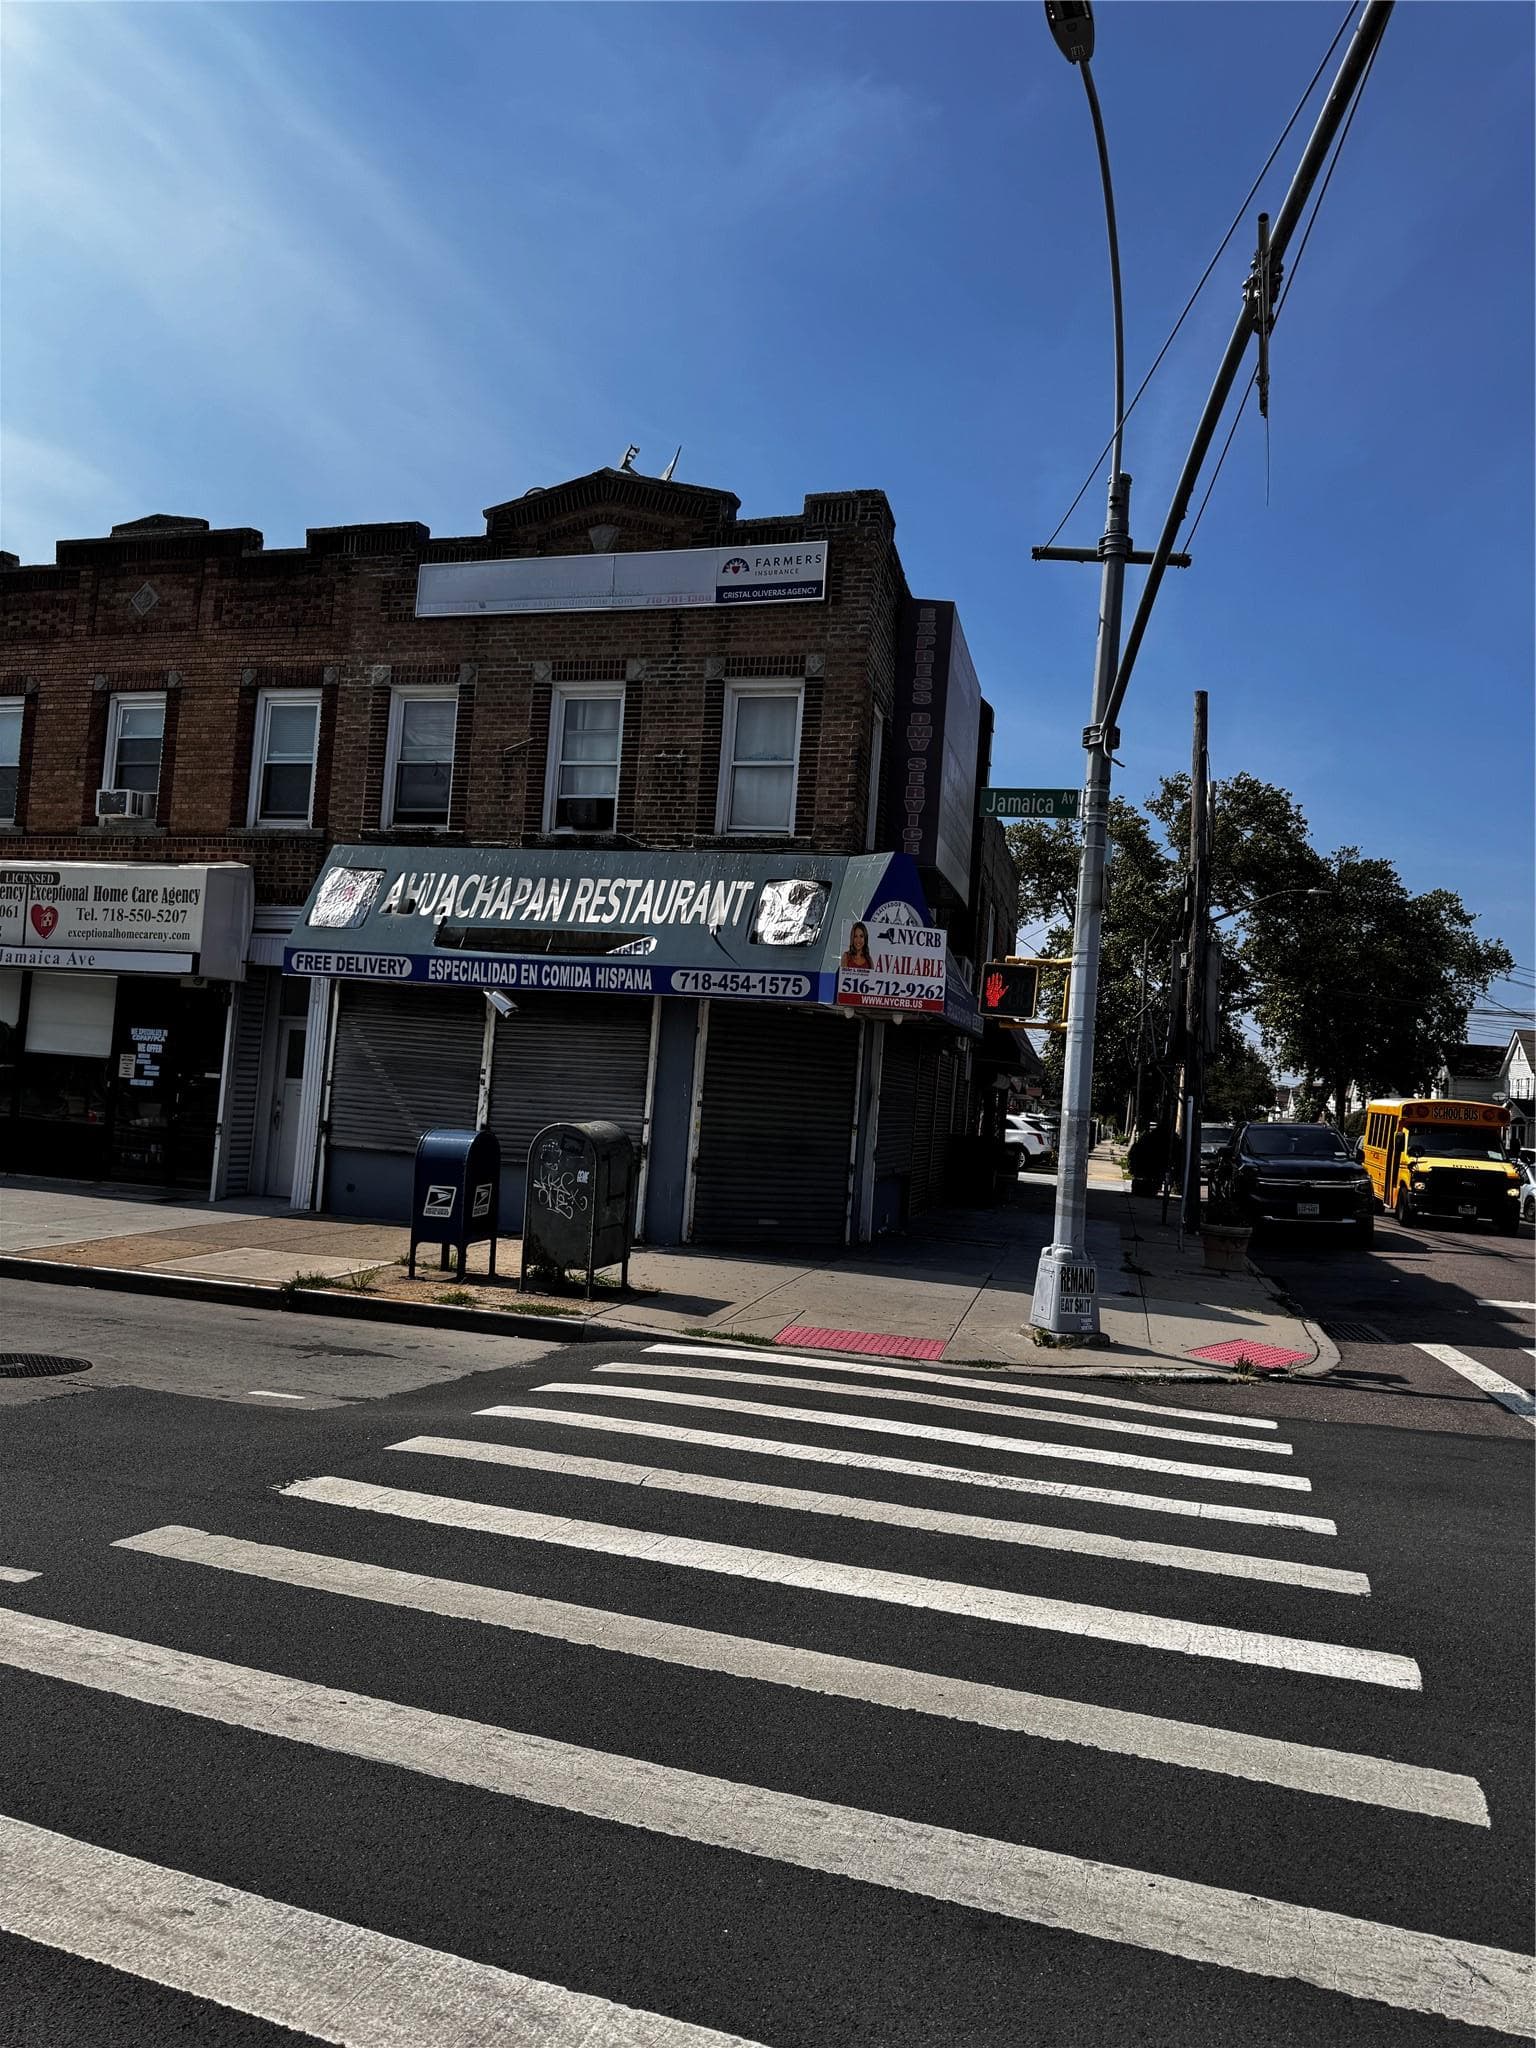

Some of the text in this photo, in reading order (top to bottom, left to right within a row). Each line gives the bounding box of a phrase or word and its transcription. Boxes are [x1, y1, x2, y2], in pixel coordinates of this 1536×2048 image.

[756, 554, 822, 568] FARMERS
[754, 568, 799, 577] INSURANCE
[722, 590, 751, 600] CRISTAL
[752, 588, 788, 598] OLIVERAS
[788, 586, 817, 596] AGENCY
[986, 792, 1075, 814] Jamaica Av
[6, 873, 54, 884] LICENSED
[30, 884, 200, 906] Exceptional Home Care Agency
[379, 872, 754, 926] AHUACHAPAN RESTAURANT
[76, 907, 188, 924] Tel. 718-550-5207
[68, 928, 190, 942] exceptionalhomecareny.com
[897, 928, 942, 948] NYCRB
[66, 951, 96, 967] Ave
[296, 954, 407, 976] FREE DELIVERY
[874, 954, 944, 978] AVAILABLE
[428, 959, 652, 991] ESPECIALIDAD EN COMIDA HISPANA
[680, 972, 803, 995] 718-454-1575
[842, 978, 944, 1000] 516-712-9262
[862, 996, 923, 1009] WWW.NYCRB.US
[1434, 1107, 1478, 1120] SCHOOL BUS
[1061, 1266, 1095, 1294] REMAND
[1060, 1298, 1074, 1312] EAT
